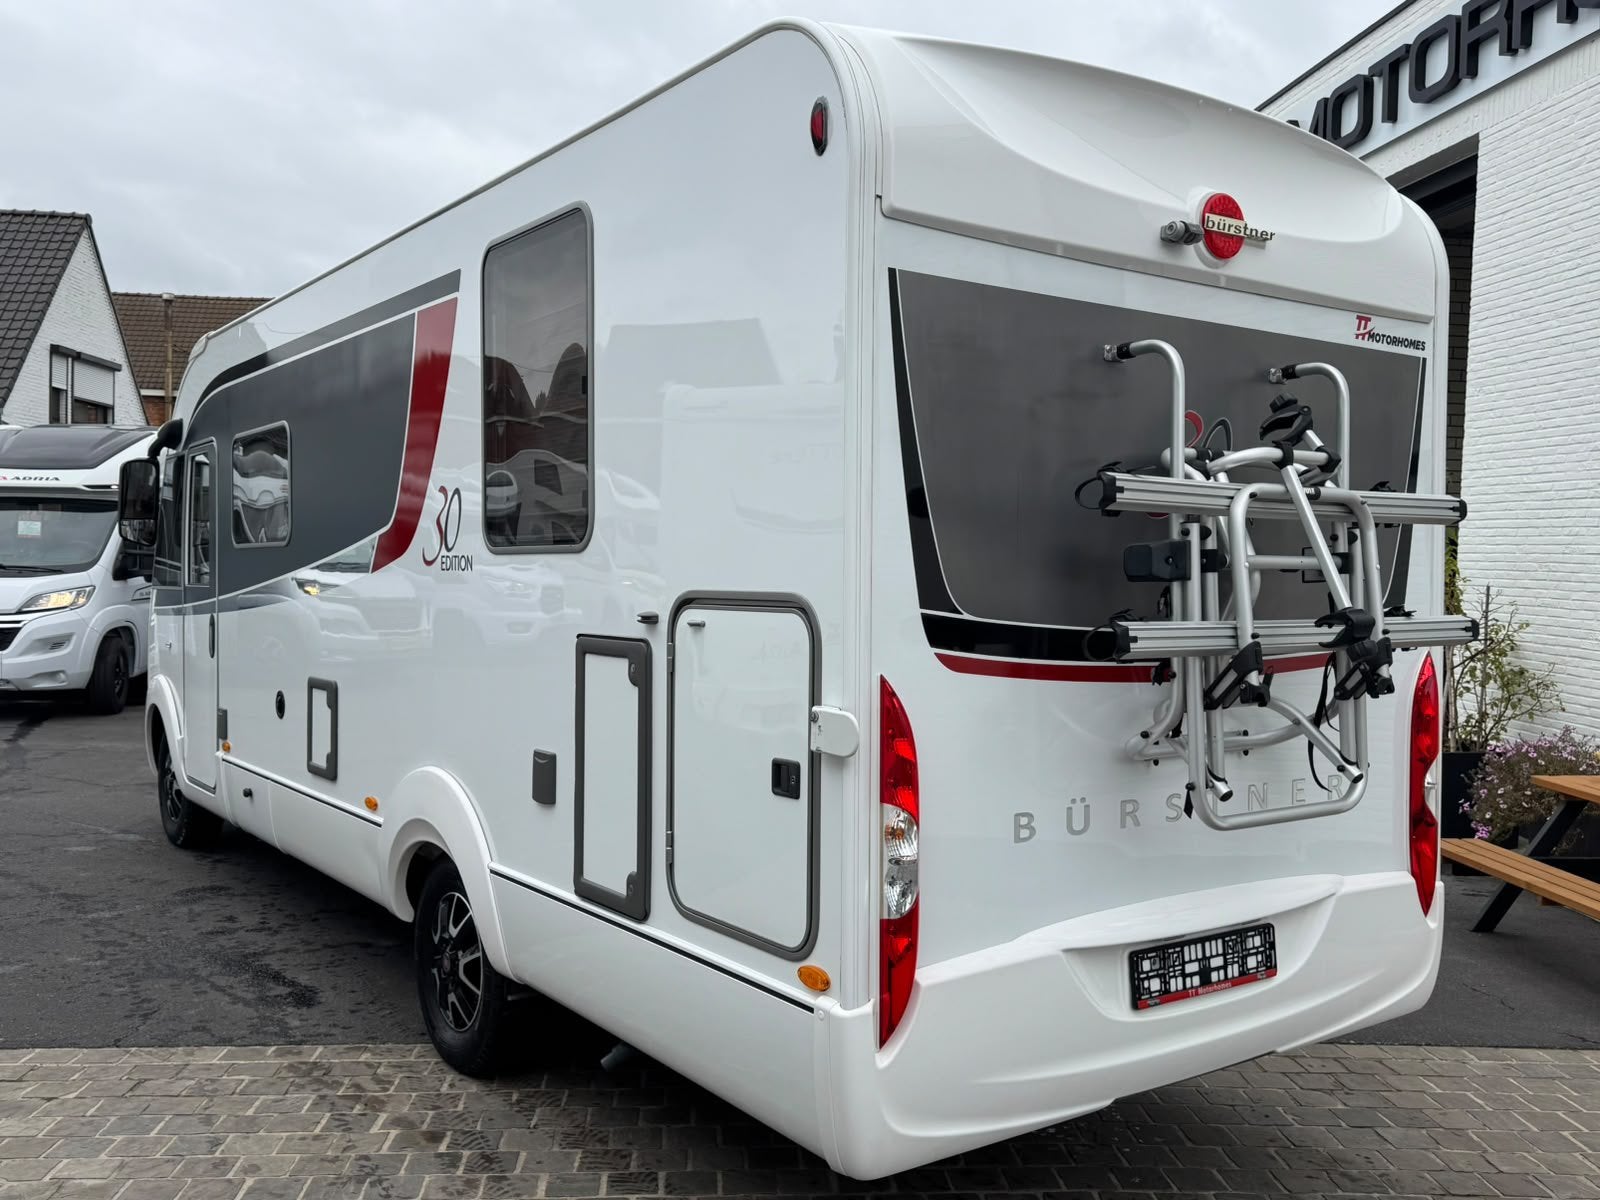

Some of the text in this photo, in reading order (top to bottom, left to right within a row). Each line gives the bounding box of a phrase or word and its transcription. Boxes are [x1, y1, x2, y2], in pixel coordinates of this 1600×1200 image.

[1205, 215, 1276, 241] bürstner
[1367, 331, 1427, 351] MOTORHOMES
[422, 485, 462, 567] 30
[440, 555, 473, 572] EDITION
[1013, 774, 1344, 844] BÜRSNER
[1188, 982, 1232, 998] TT Motorhomes
